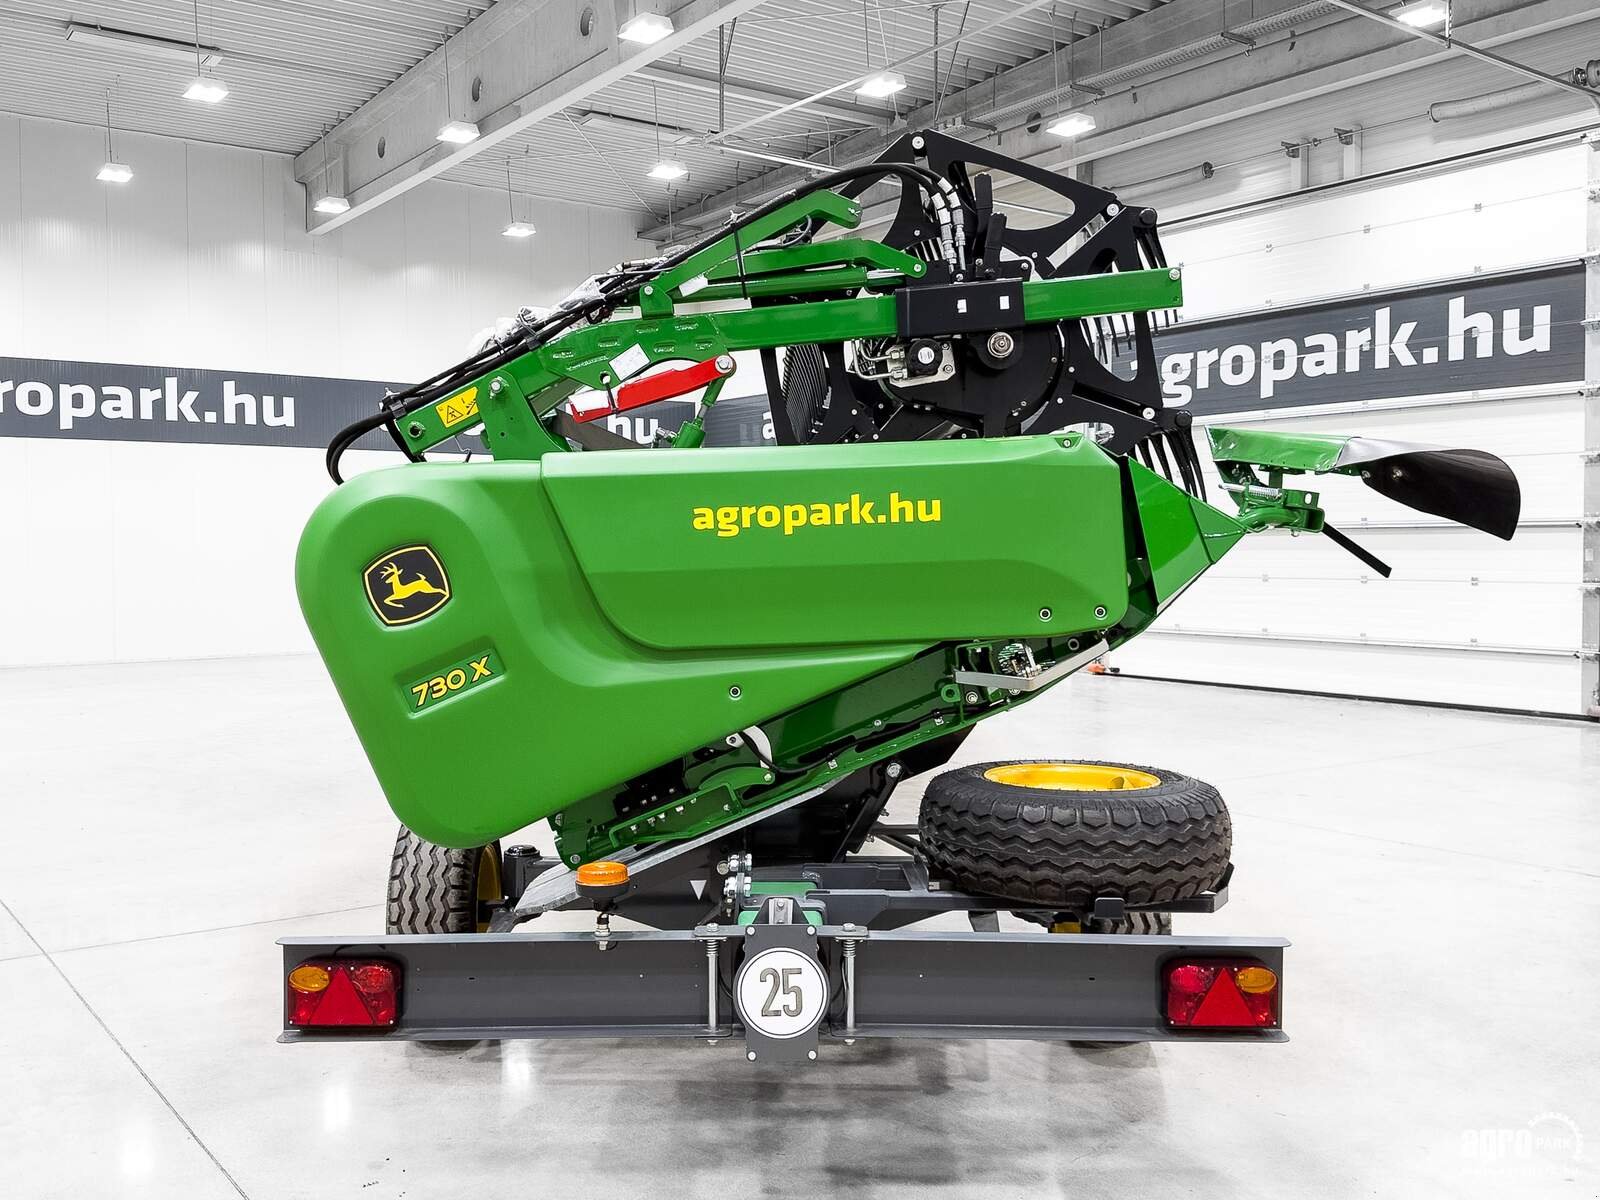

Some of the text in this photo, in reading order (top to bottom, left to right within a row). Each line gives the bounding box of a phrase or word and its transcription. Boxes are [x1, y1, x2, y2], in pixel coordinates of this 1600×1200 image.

[1130, 296, 1551, 408] gropark.hu
[692, 492, 942, 537] agropark.hu
[411, 655, 494, 708] 730 X
[759, 967, 803, 1017] 25
